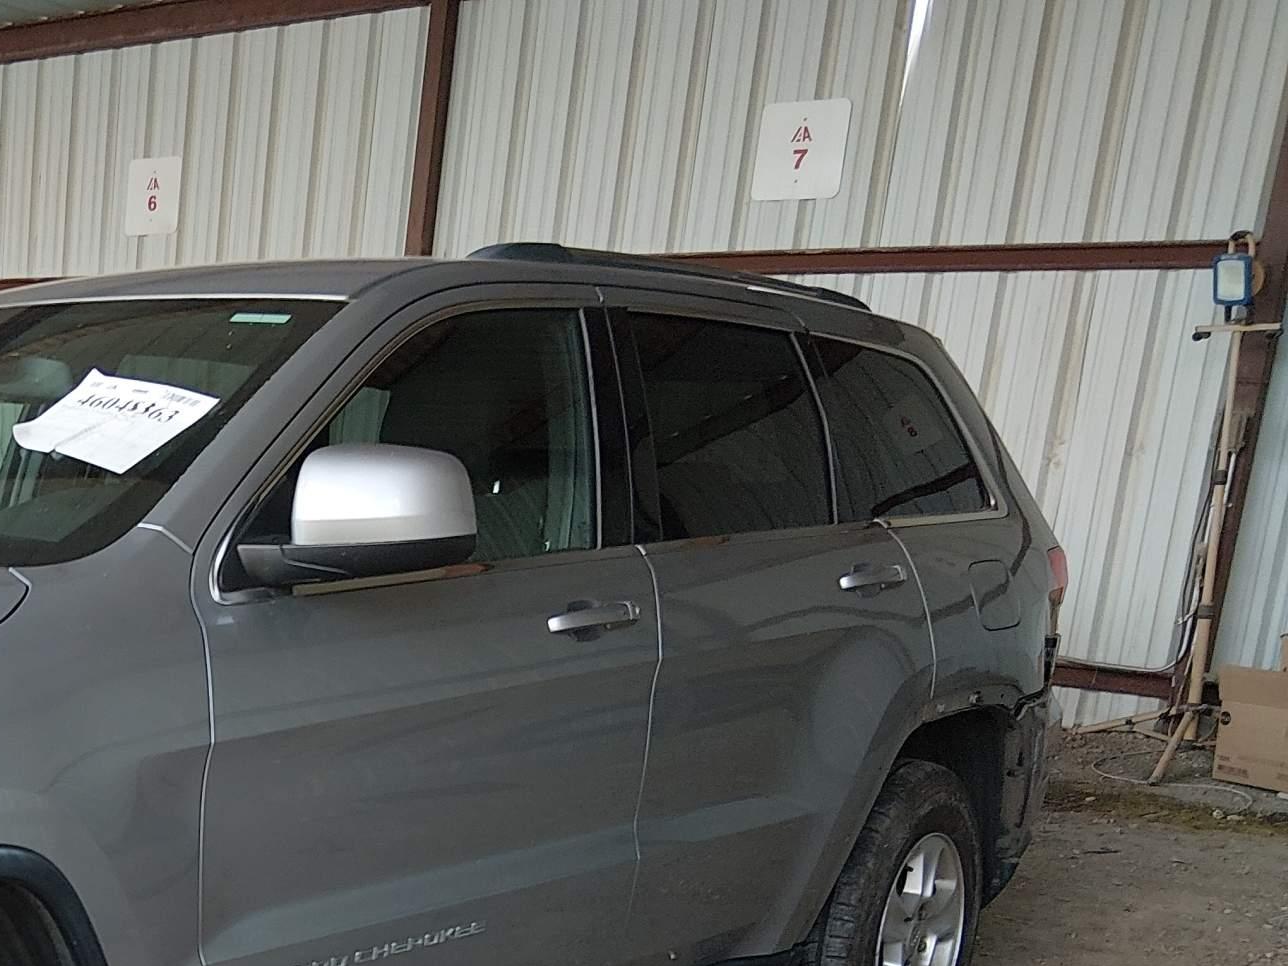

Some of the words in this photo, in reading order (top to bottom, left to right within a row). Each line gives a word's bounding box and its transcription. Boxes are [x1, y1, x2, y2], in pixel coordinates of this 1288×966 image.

[792, 148, 809, 170] 7
[147, 195, 157, 212] 6
[352, 921, 487, 965] CHEROKEE
